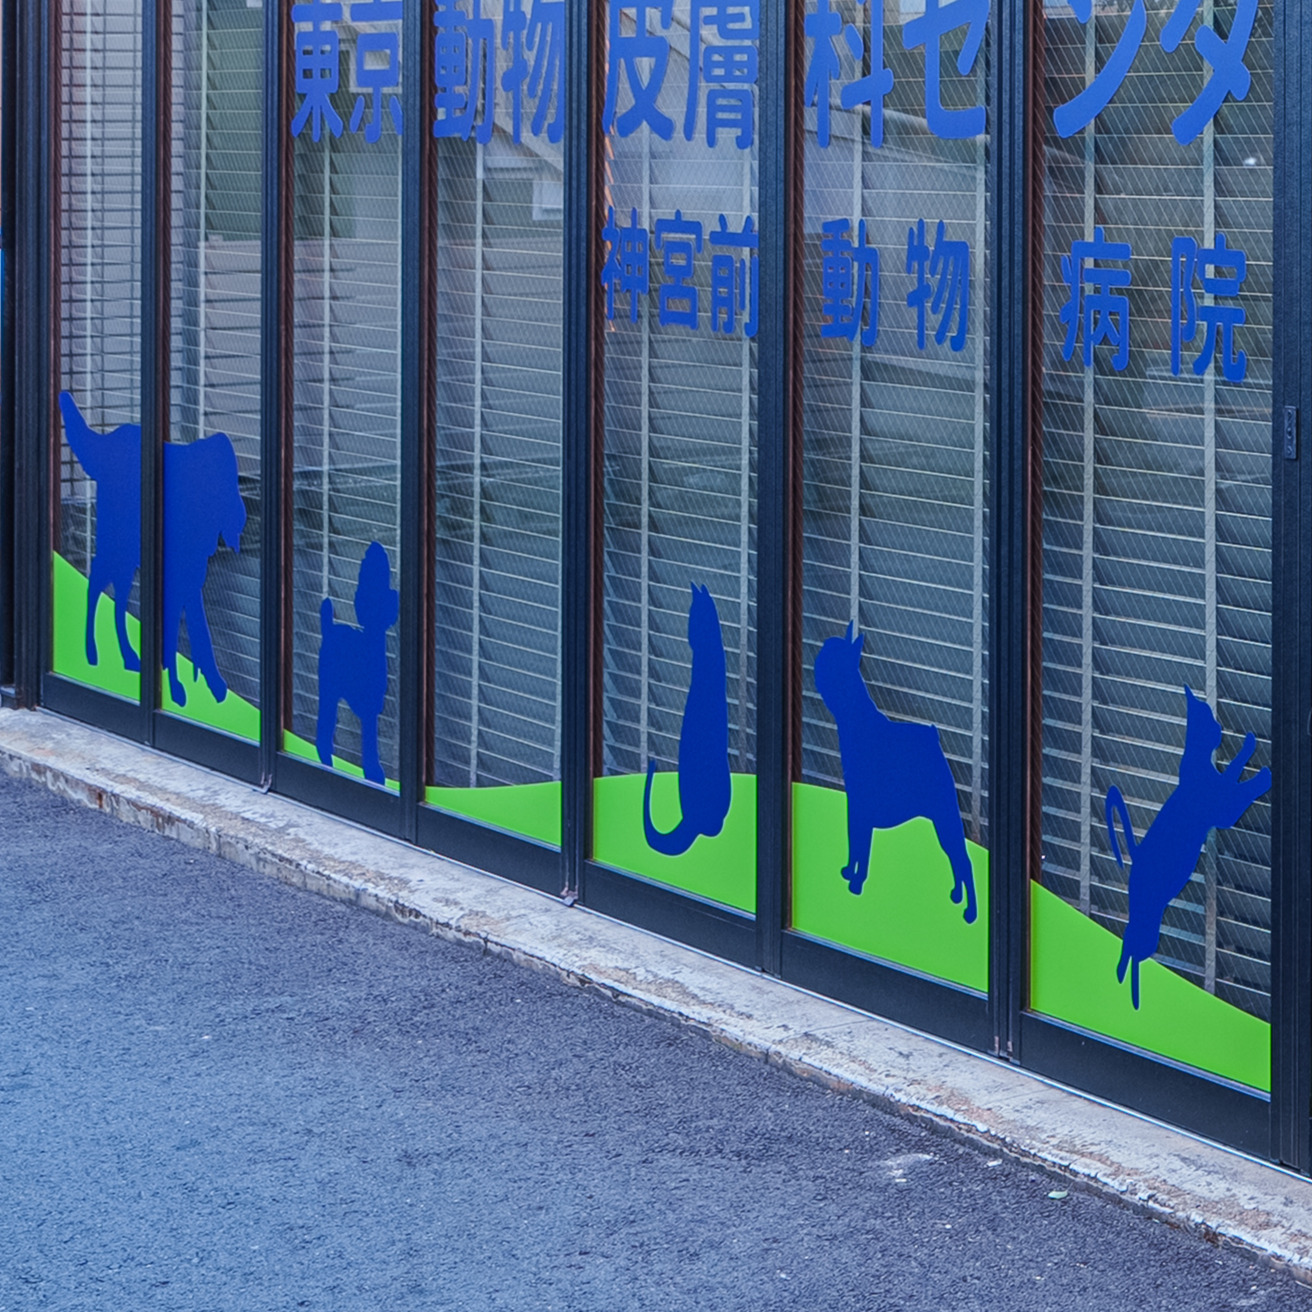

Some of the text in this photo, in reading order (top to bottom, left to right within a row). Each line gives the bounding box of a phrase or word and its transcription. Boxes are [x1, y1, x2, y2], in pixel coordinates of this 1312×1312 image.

[600, 206, 1248, 383] 神宮前動物病院
